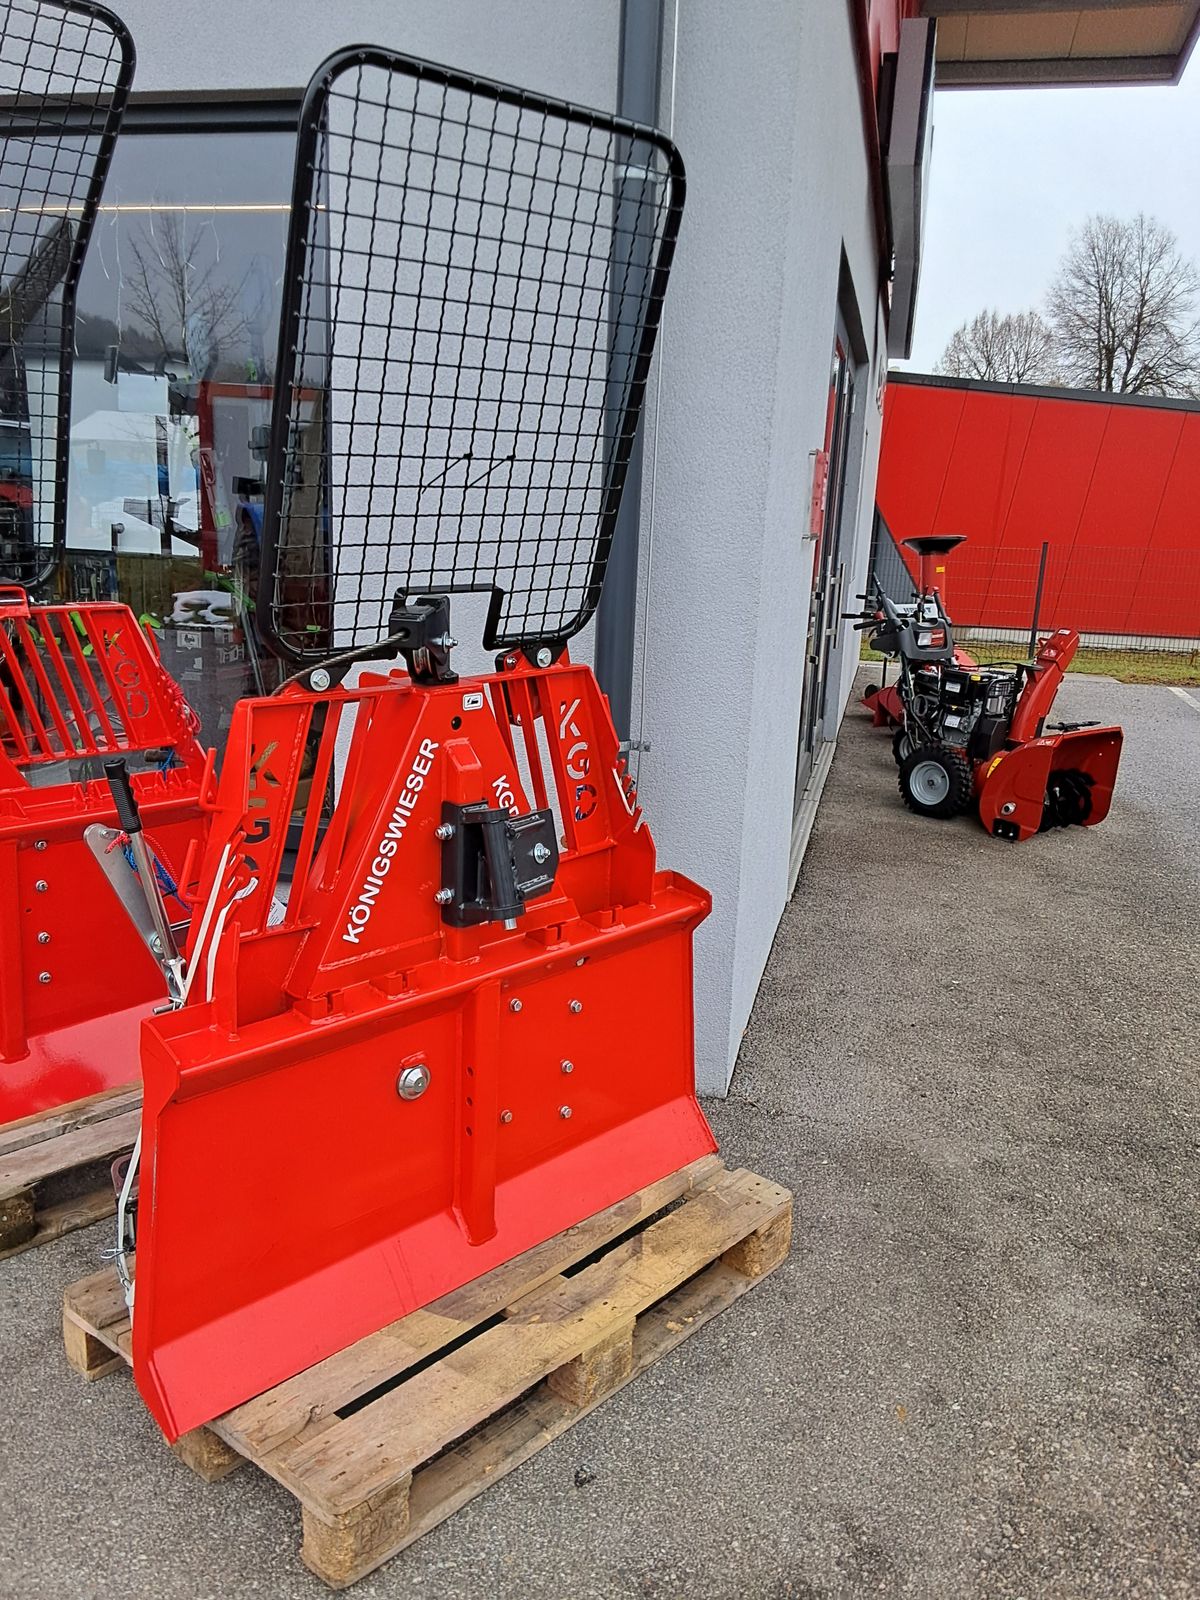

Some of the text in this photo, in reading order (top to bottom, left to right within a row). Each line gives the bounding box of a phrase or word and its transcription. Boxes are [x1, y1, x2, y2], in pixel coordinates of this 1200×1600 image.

[103, 628, 150, 718] KGD
[560, 698, 597, 821] KGD
[342, 738, 439, 943] KÖNIGSWIESER
